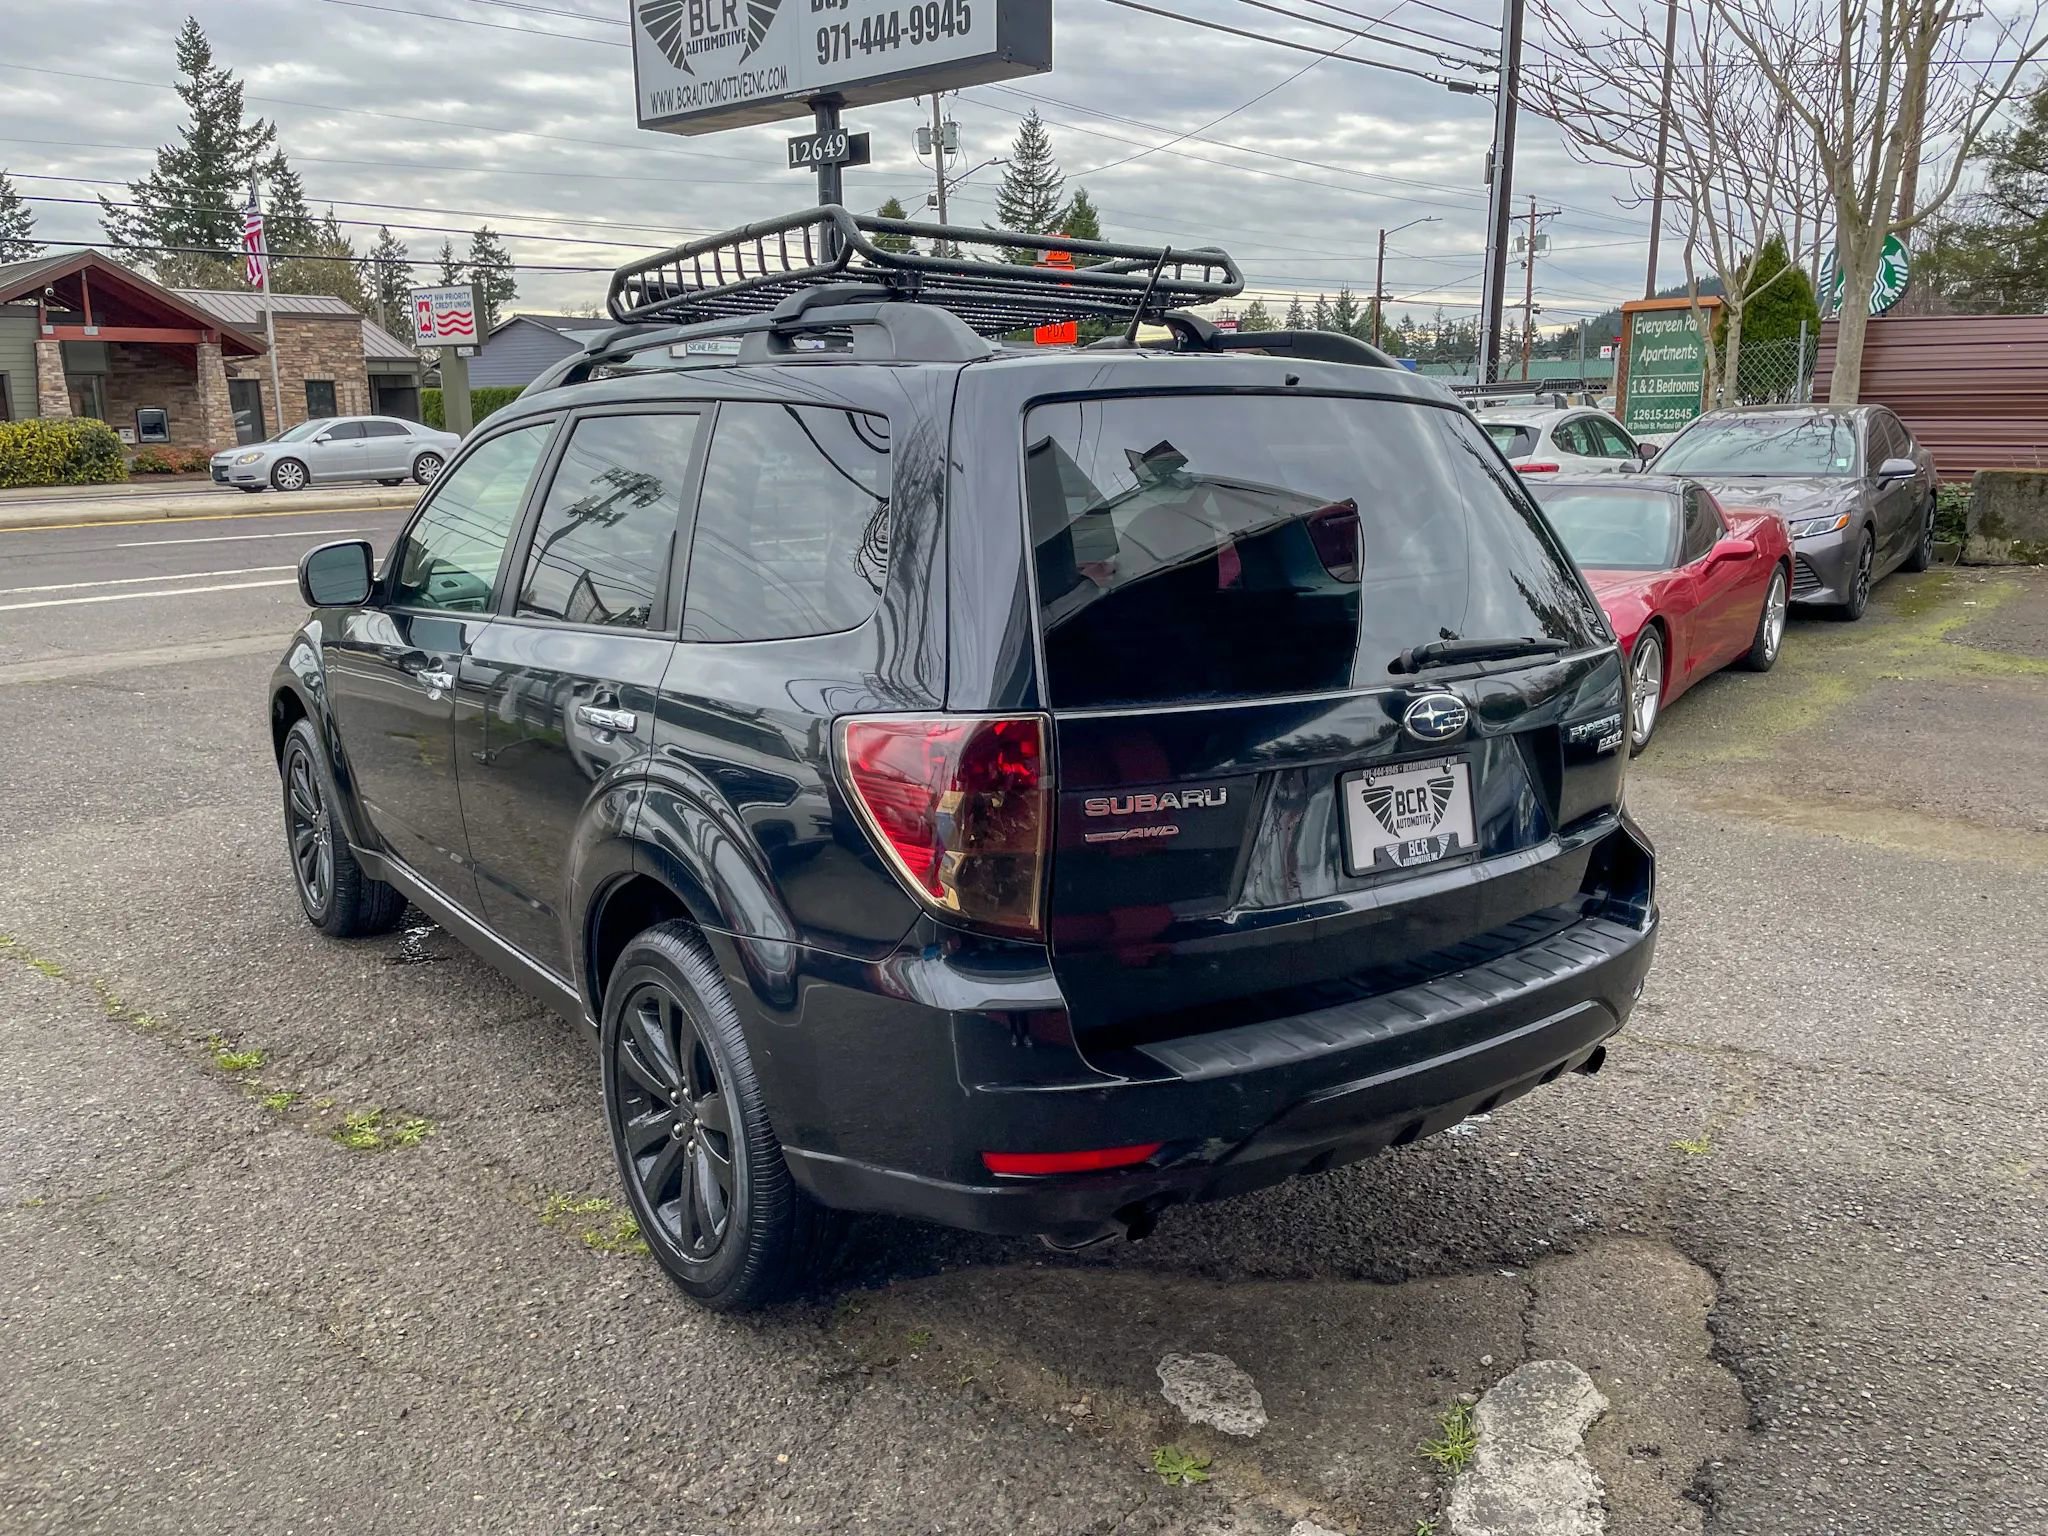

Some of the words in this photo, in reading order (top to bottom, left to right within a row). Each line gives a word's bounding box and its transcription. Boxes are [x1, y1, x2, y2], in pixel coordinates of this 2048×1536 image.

[688, 0, 738, 38] BCR
[686, 28, 747, 56] AUTOMOTIVE
[816, 0, 971, 66] 971-444-9945
[650, 65, 789, 115] WWW.BCRAUTOMOTIVEINC.COM
[790, 134, 847, 163] 12649
[445, 291, 470, 300] PRIORITY
[1635, 316, 1682, 338] Evergreen
[1638, 343, 1698, 366] Apartments
[1631, 380, 1638, 394] 1
[1639, 379, 1647, 393] &
[1648, 379, 1655, 393] 2
[1656, 378, 1699, 393] Bedrooms
[1633, 408, 1692, 420] 12615-12645
[1084, 787, 1227, 817] SUBARU
[1395, 787, 1429, 817] BCR
[1121, 824, 1180, 840] AWD
[1396, 813, 1432, 830] AUTOMOTIVE
[1408, 838, 1430, 857] BCR
